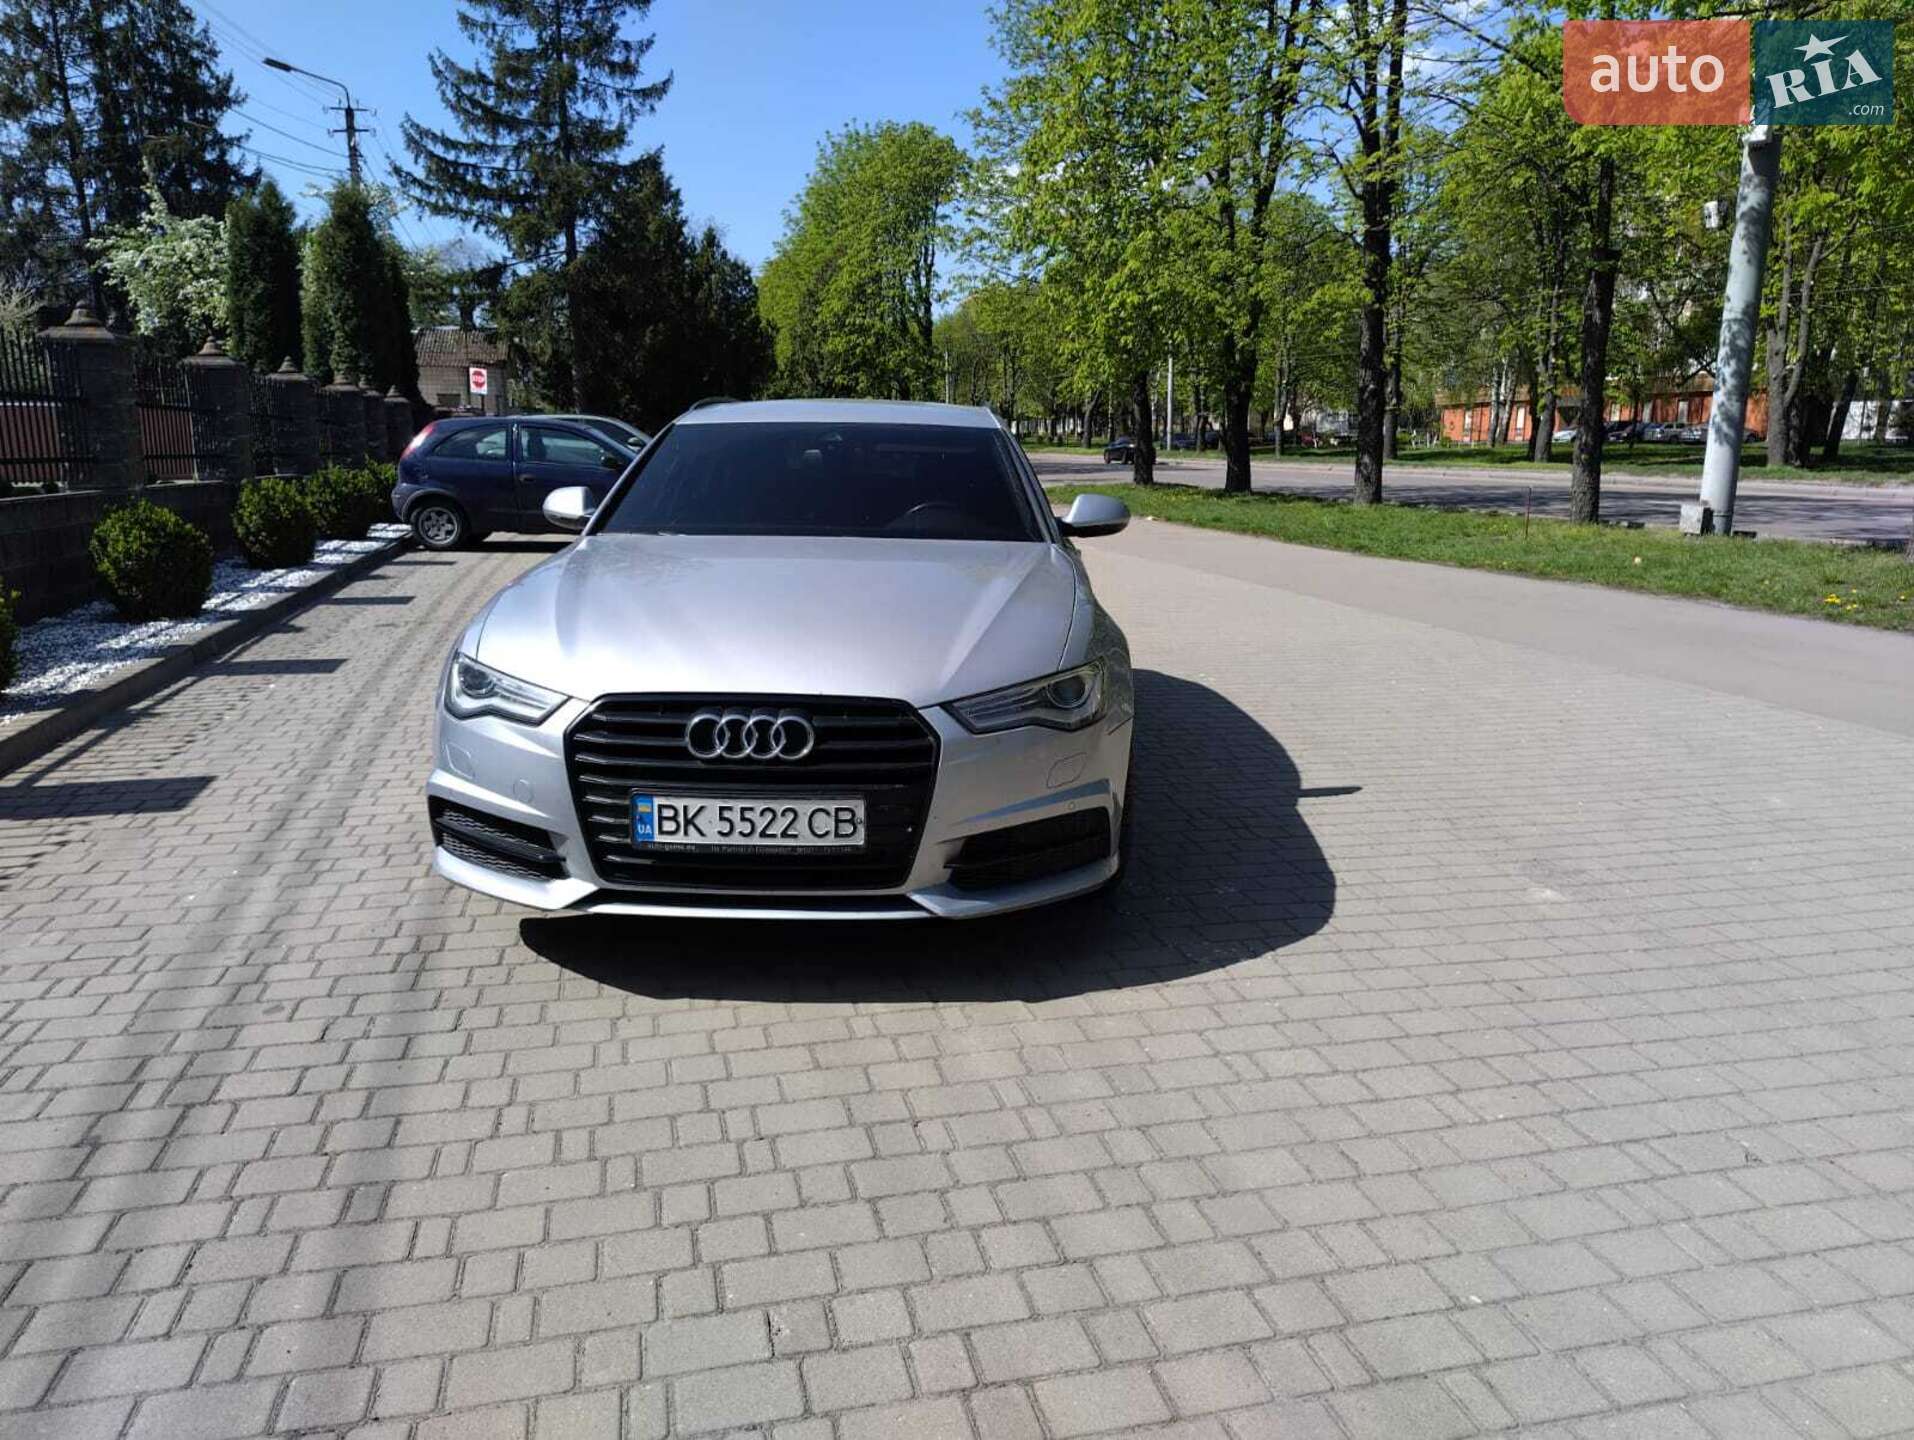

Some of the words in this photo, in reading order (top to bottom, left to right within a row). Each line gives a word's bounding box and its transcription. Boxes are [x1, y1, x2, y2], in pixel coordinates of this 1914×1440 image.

[637, 823, 652, 834] UA
[657, 803, 707, 837] BK
[717, 806, 799, 838] 5522
[807, 807, 858, 839] CB
